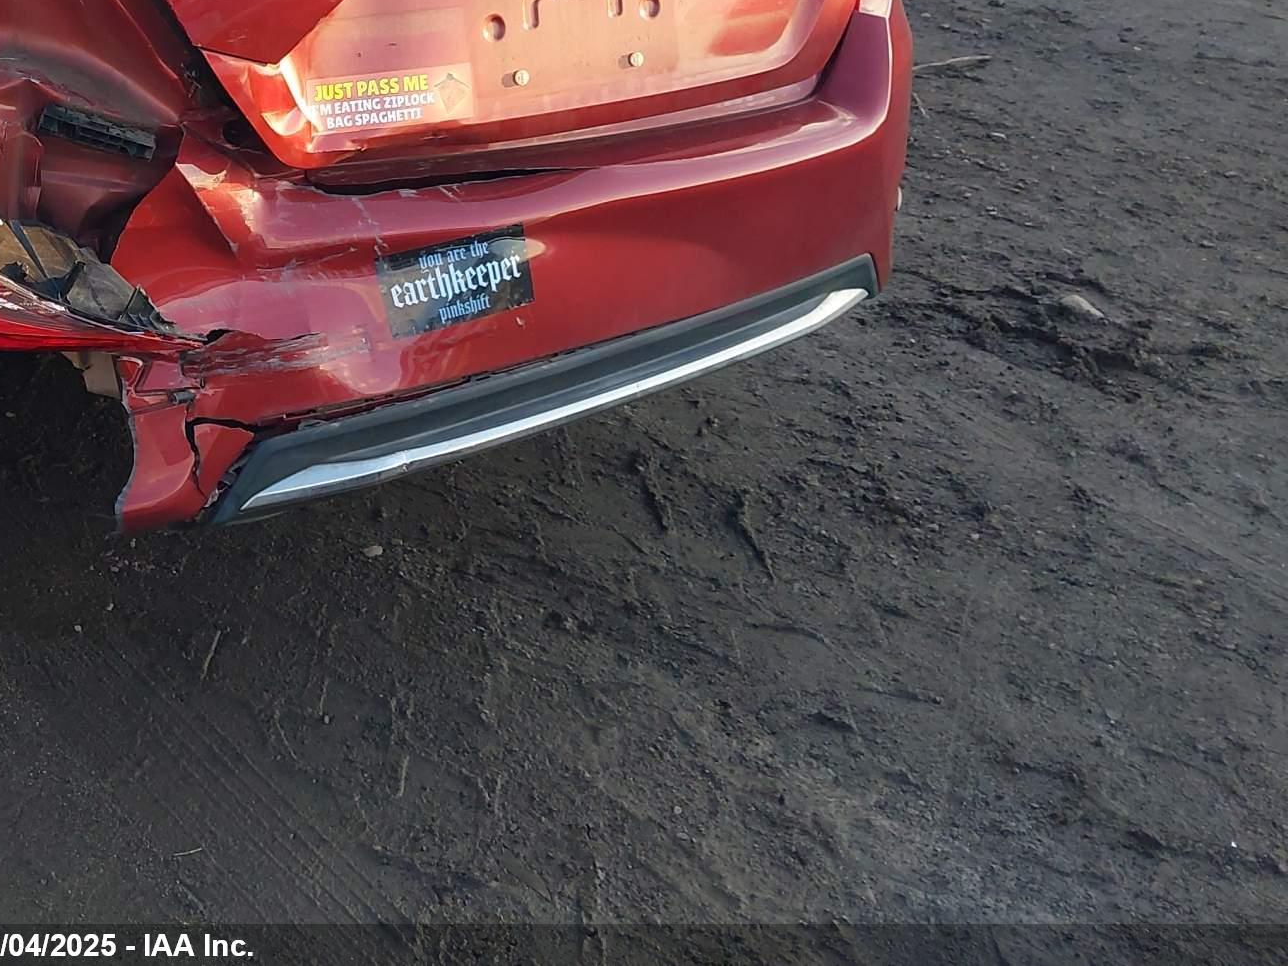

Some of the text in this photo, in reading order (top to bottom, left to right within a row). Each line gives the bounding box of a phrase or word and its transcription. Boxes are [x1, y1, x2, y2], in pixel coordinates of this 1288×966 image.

[315, 74, 429, 102] JUST PASS ME
[334, 98, 381, 114] EATING
[383, 92, 435, 109] ZIPLOCK
[326, 108, 423, 130] BAG SPAGHETTI
[418, 240, 489, 271] you are the
[390, 254, 521, 308] earthkeeper
[439, 293, 491, 324] pinkshift
